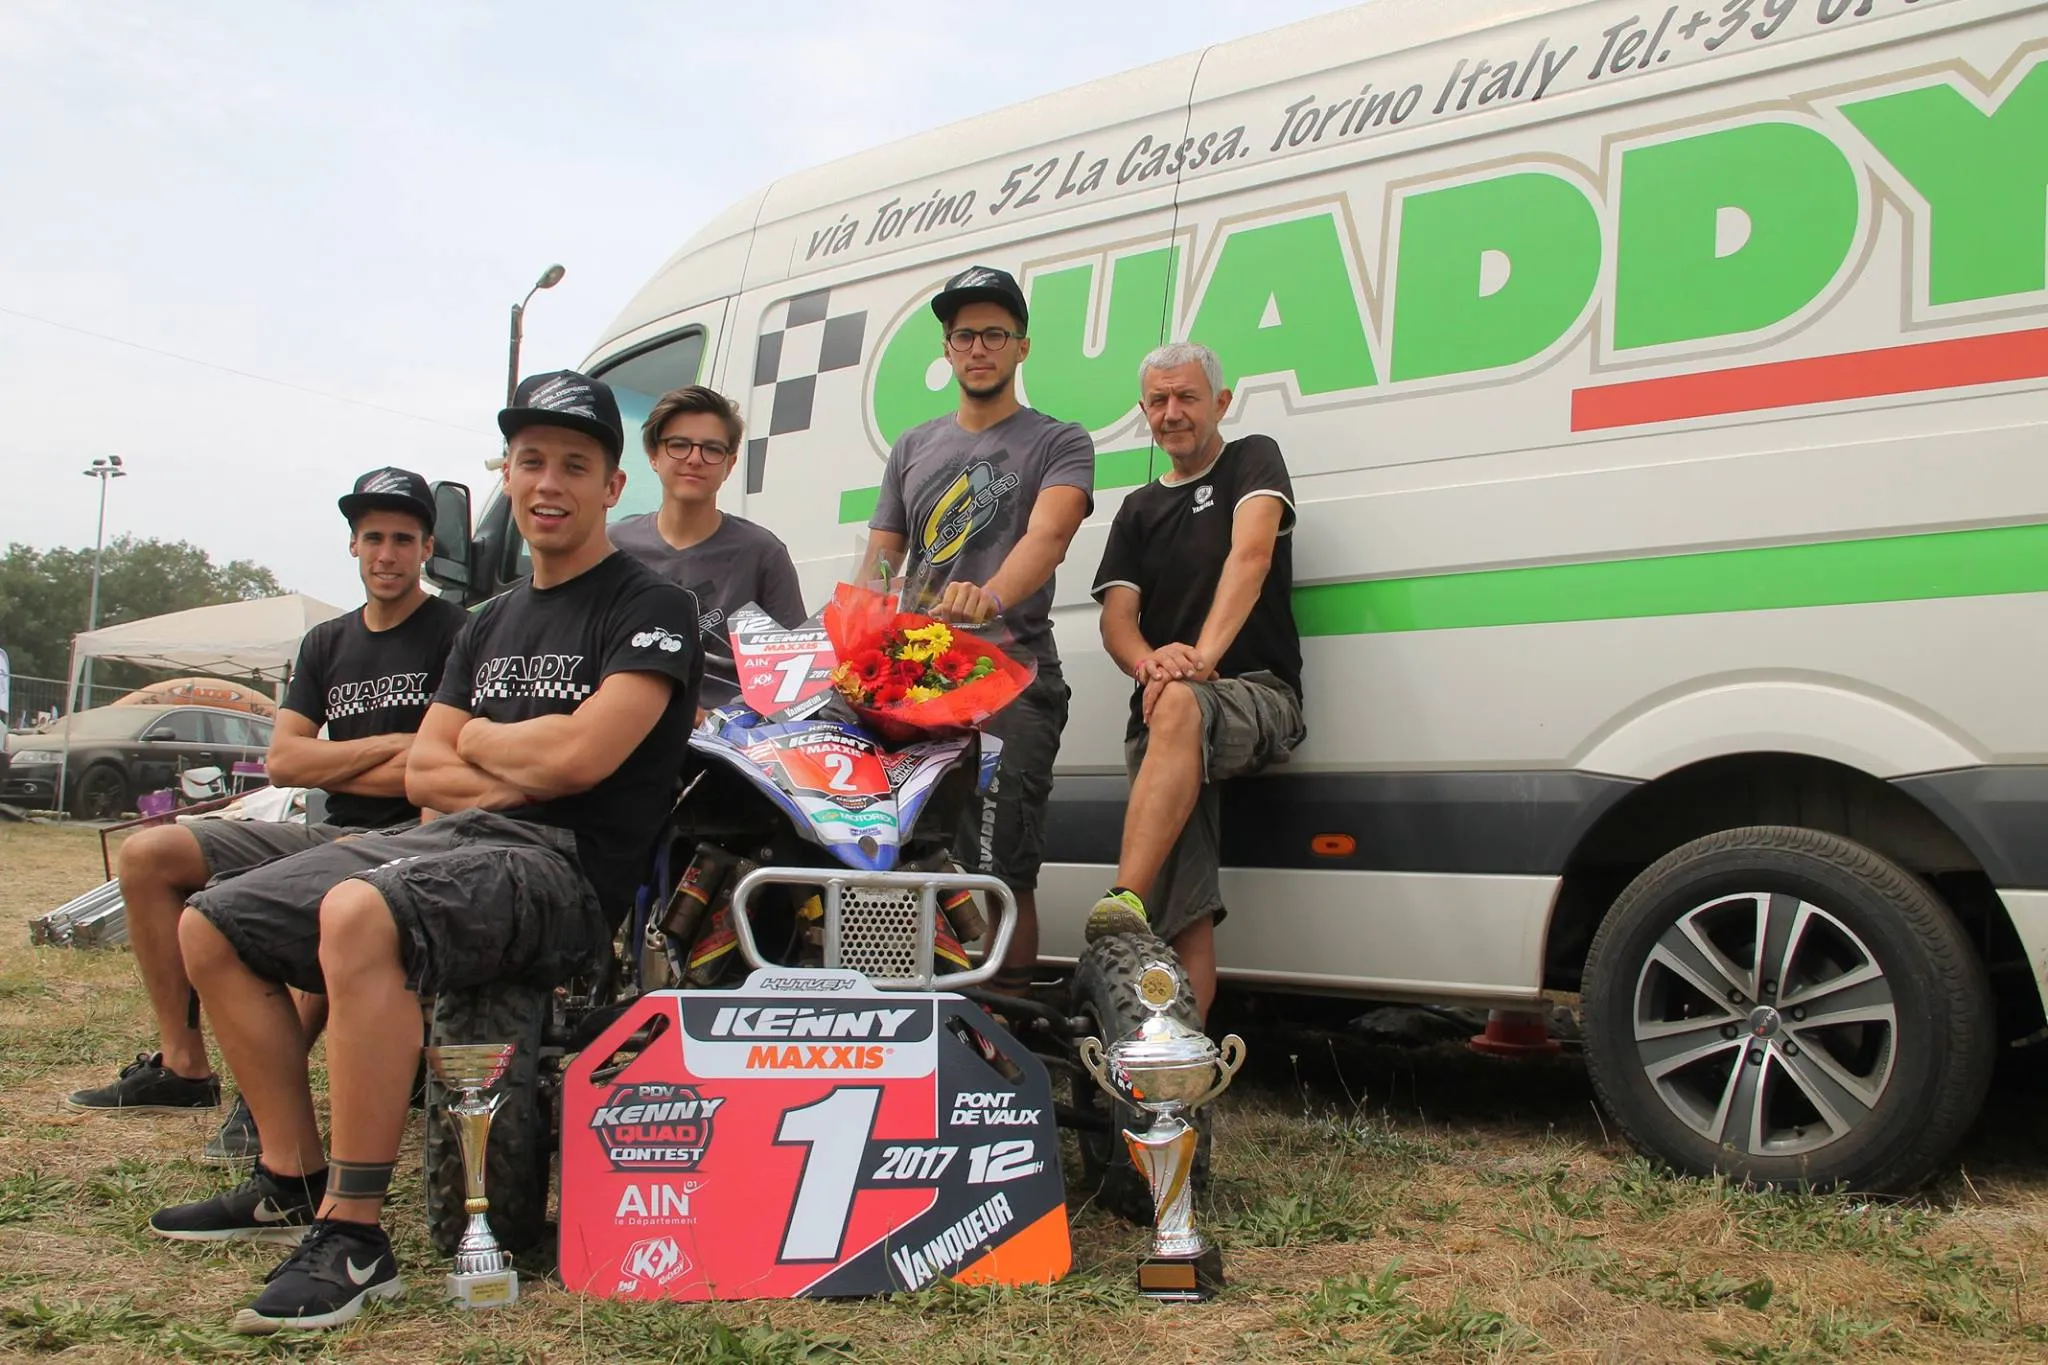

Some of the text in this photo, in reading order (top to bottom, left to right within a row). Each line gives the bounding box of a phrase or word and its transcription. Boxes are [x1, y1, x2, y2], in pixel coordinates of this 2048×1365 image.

[805, 213, 859, 261] via
[865, 188, 976, 246] Torino,
[989, 157, 1059, 215] 52
[1055, 151, 1108, 200] La
[1116, 125, 1250, 185] Cassa.
[1270, 84, 1423, 151] Torino
[1432, 36, 1578, 113] Italy
[872, 58, 2048, 445] QUADDY
[750, 632, 828, 644] KENNY
[476, 655, 584, 688] QUADDY
[744, 659, 768, 667] AIN
[328, 673, 428, 706] QUADDY
[774, 654, 816, 703] 1
[789, 732, 870, 751] KENNY
[825, 753, 857, 791] 2
[711, 1008, 916, 1037] KENNY
[746, 1046, 885, 1069] MAXXIS
[639, 1086, 676, 1097] PDV
[954, 1093, 1016, 1108] PONT
[591, 1098, 725, 1127] KENNY
[950, 1110, 1041, 1125] DE VAUX
[614, 1125, 698, 1143] QUAD
[610, 1148, 704, 1161] CONTEST
[872, 1147, 959, 1179] 2017
[777, 1087, 880, 1261] 1
[615, 1184, 689, 1217] AIN
[892, 1191, 1014, 1292] VAINQUEUR
